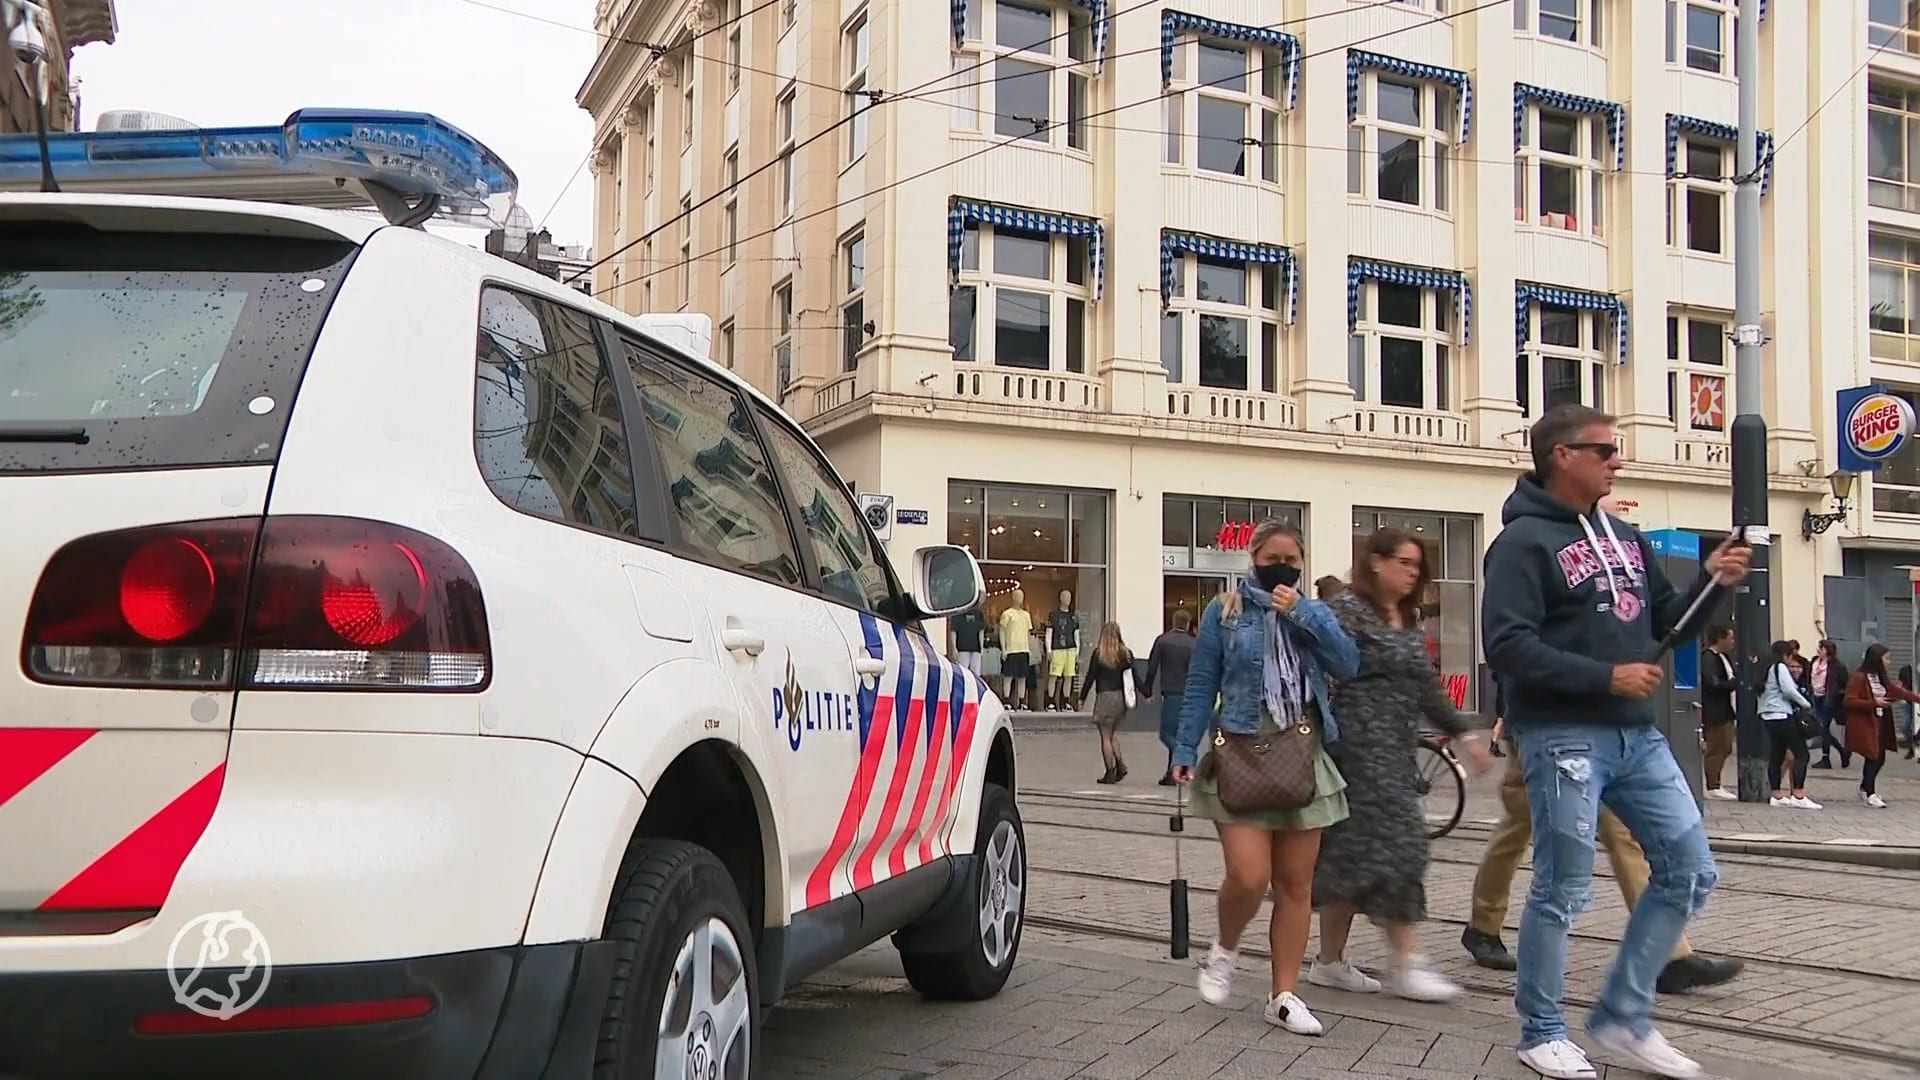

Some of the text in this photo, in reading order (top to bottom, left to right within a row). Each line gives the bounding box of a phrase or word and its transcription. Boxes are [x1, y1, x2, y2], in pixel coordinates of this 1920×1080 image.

[1852, 404, 1898, 431] BURGER
[1854, 415, 1900, 446] KING
[773, 688, 852, 751] POLITIE
